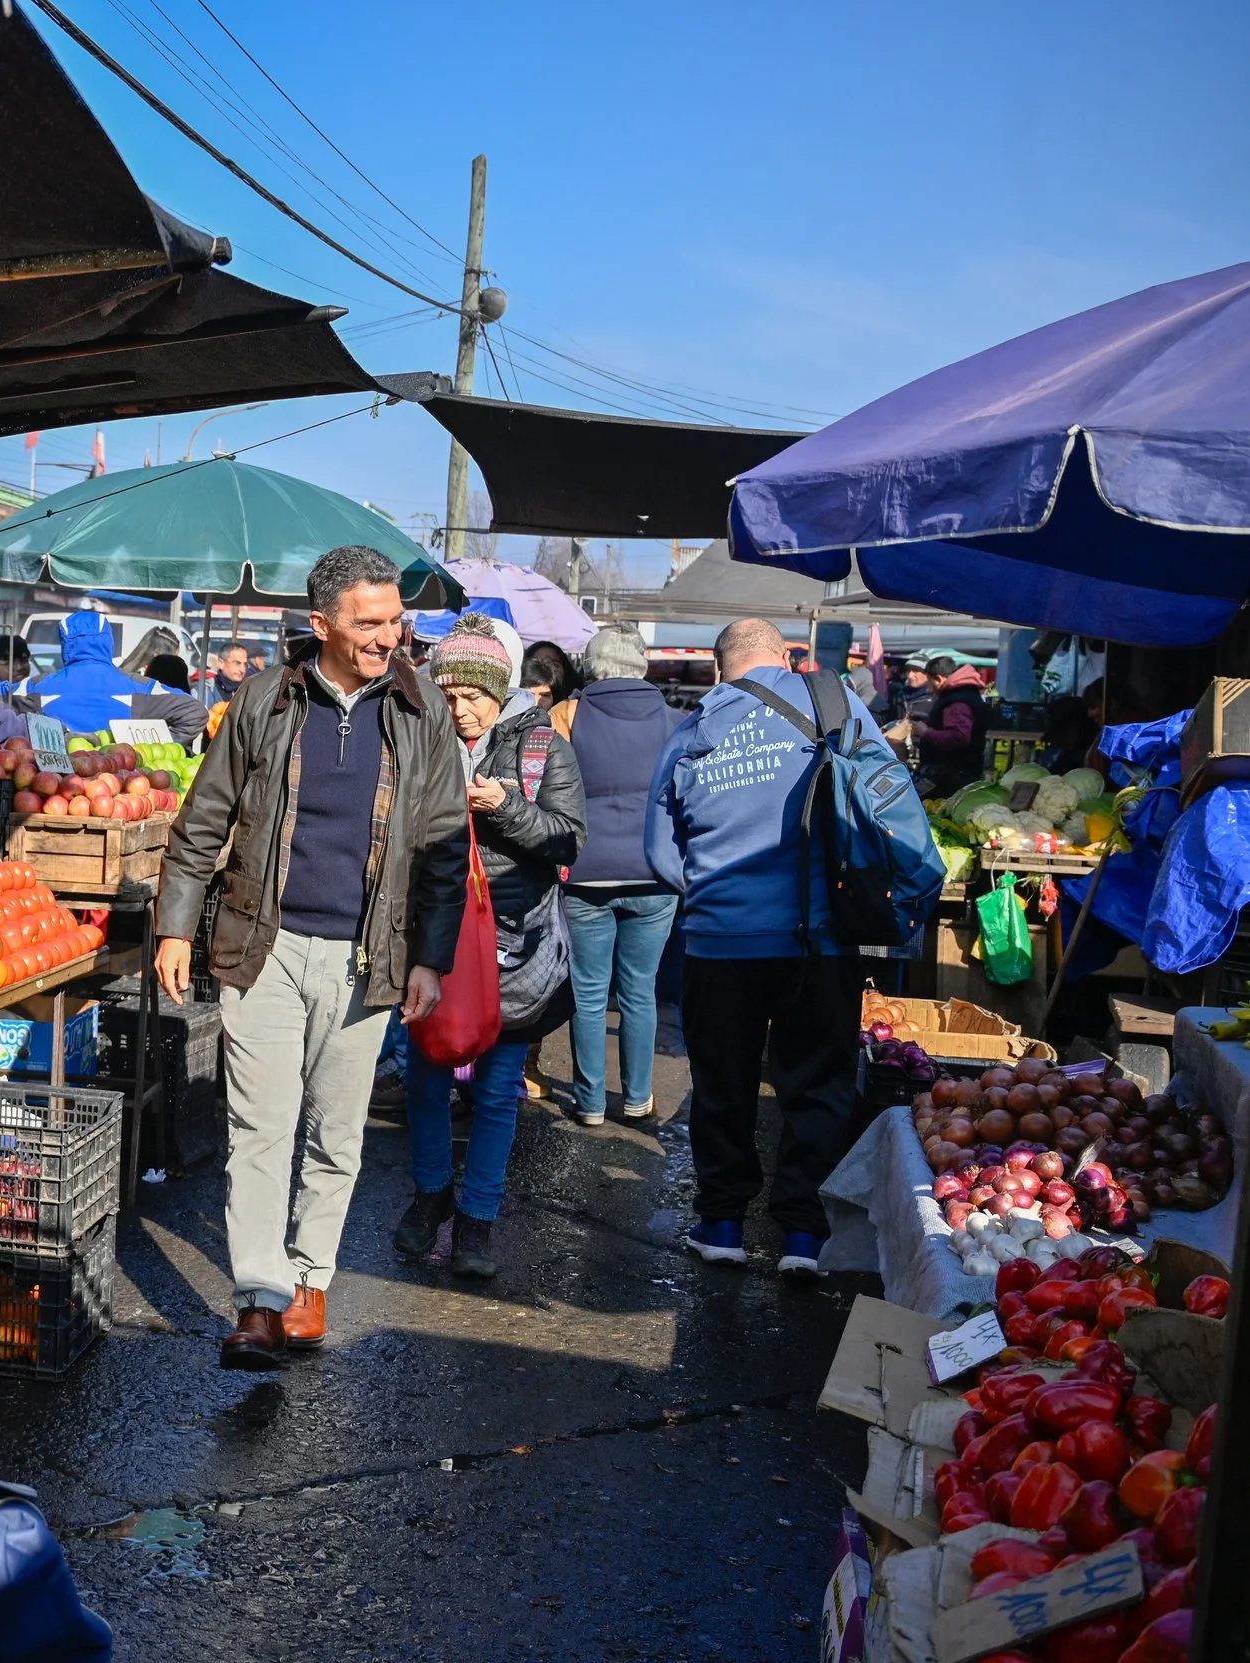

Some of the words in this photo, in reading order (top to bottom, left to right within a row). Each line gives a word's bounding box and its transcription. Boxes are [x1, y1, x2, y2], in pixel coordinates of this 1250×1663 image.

[746, 740, 796, 757] Company
[698, 756, 781, 784] CALIFORNIA
[710, 777, 754, 794] ESTABLISHED
